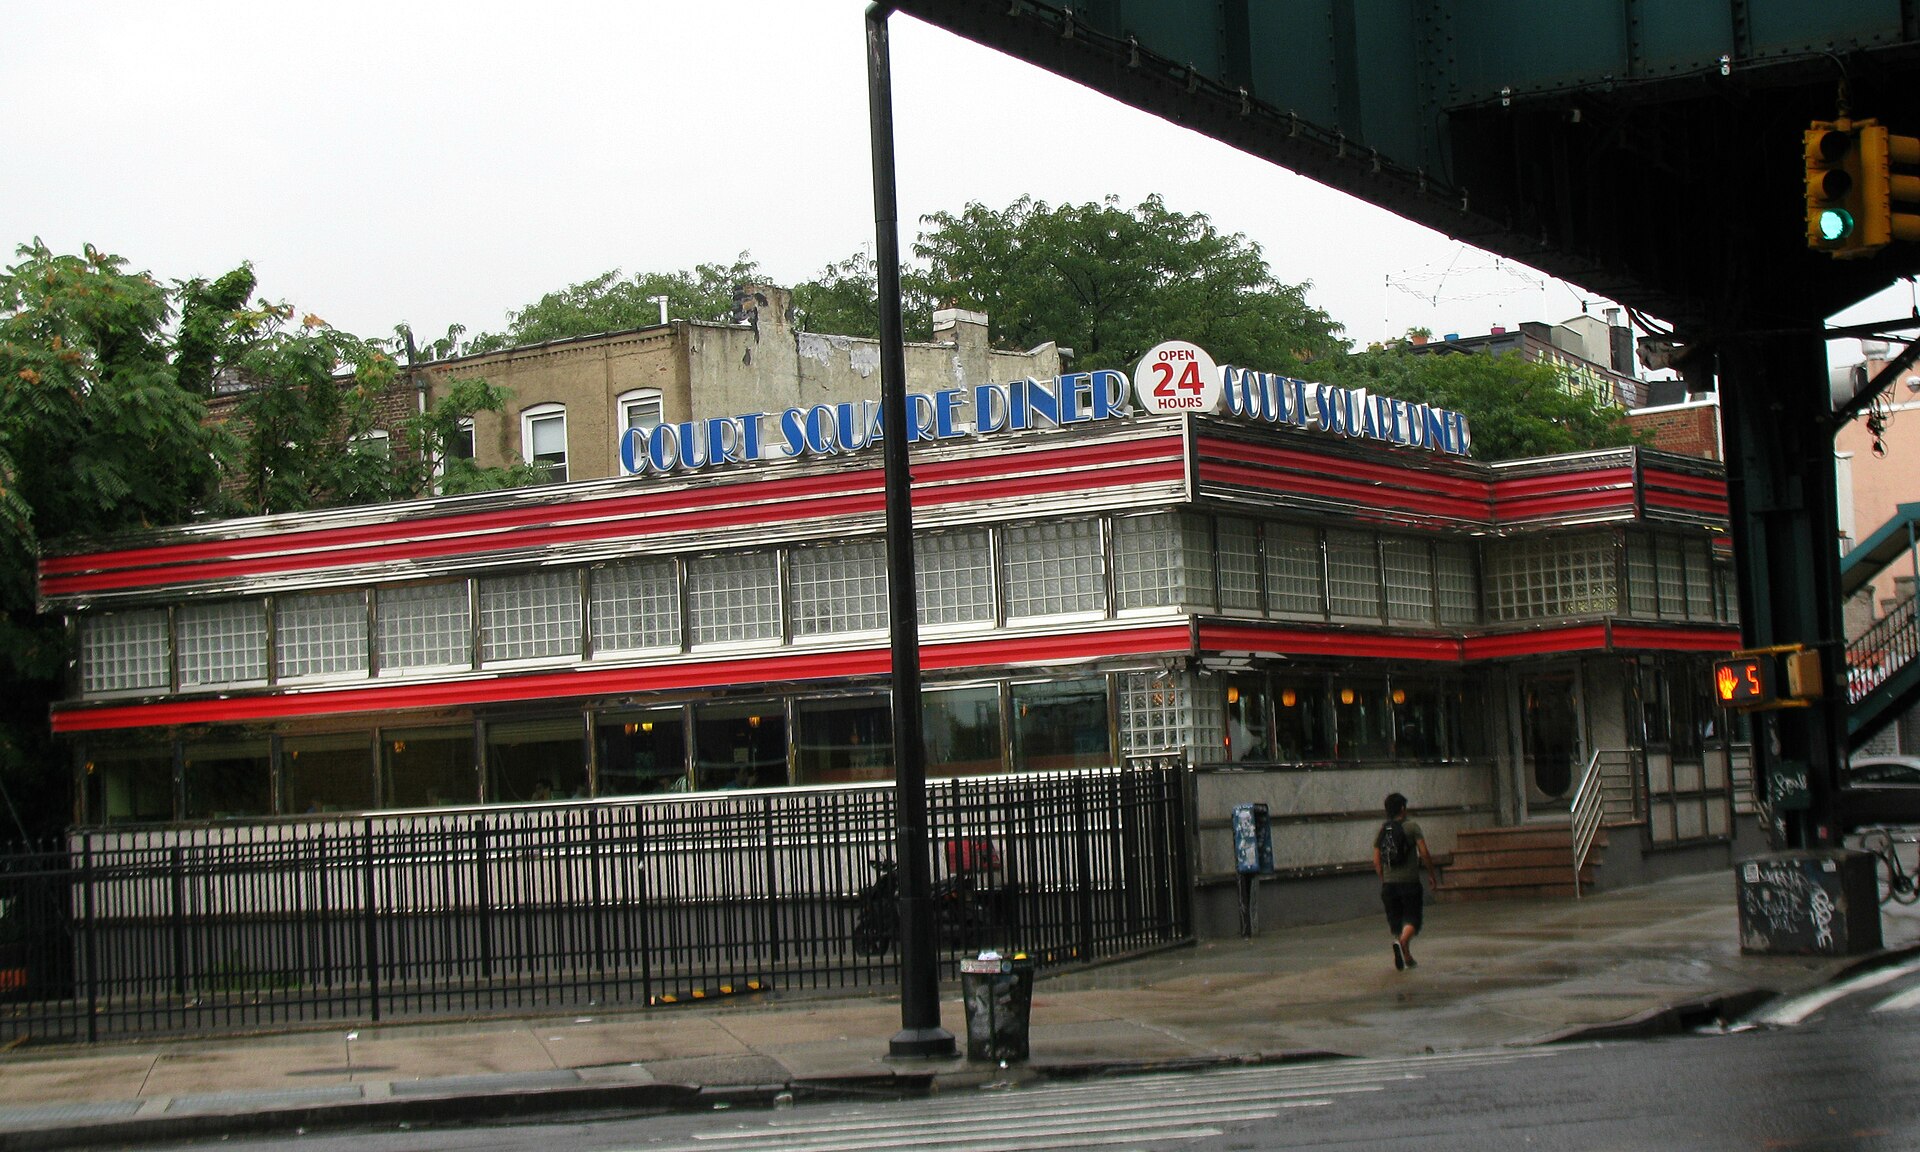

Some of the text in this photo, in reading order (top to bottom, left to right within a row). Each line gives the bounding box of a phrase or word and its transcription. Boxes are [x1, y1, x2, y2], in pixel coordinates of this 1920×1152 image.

[1158, 350, 1195, 361] OPEN
[1152, 361, 1205, 397] 24
[1158, 397, 1203, 409] HOURS
[1223, 363, 1472, 457] COURT SQUARE DINER
[620, 411, 765, 475] COURT
[975, 369, 1128, 434] DINER
[1745, 665, 1760, 695] 5
